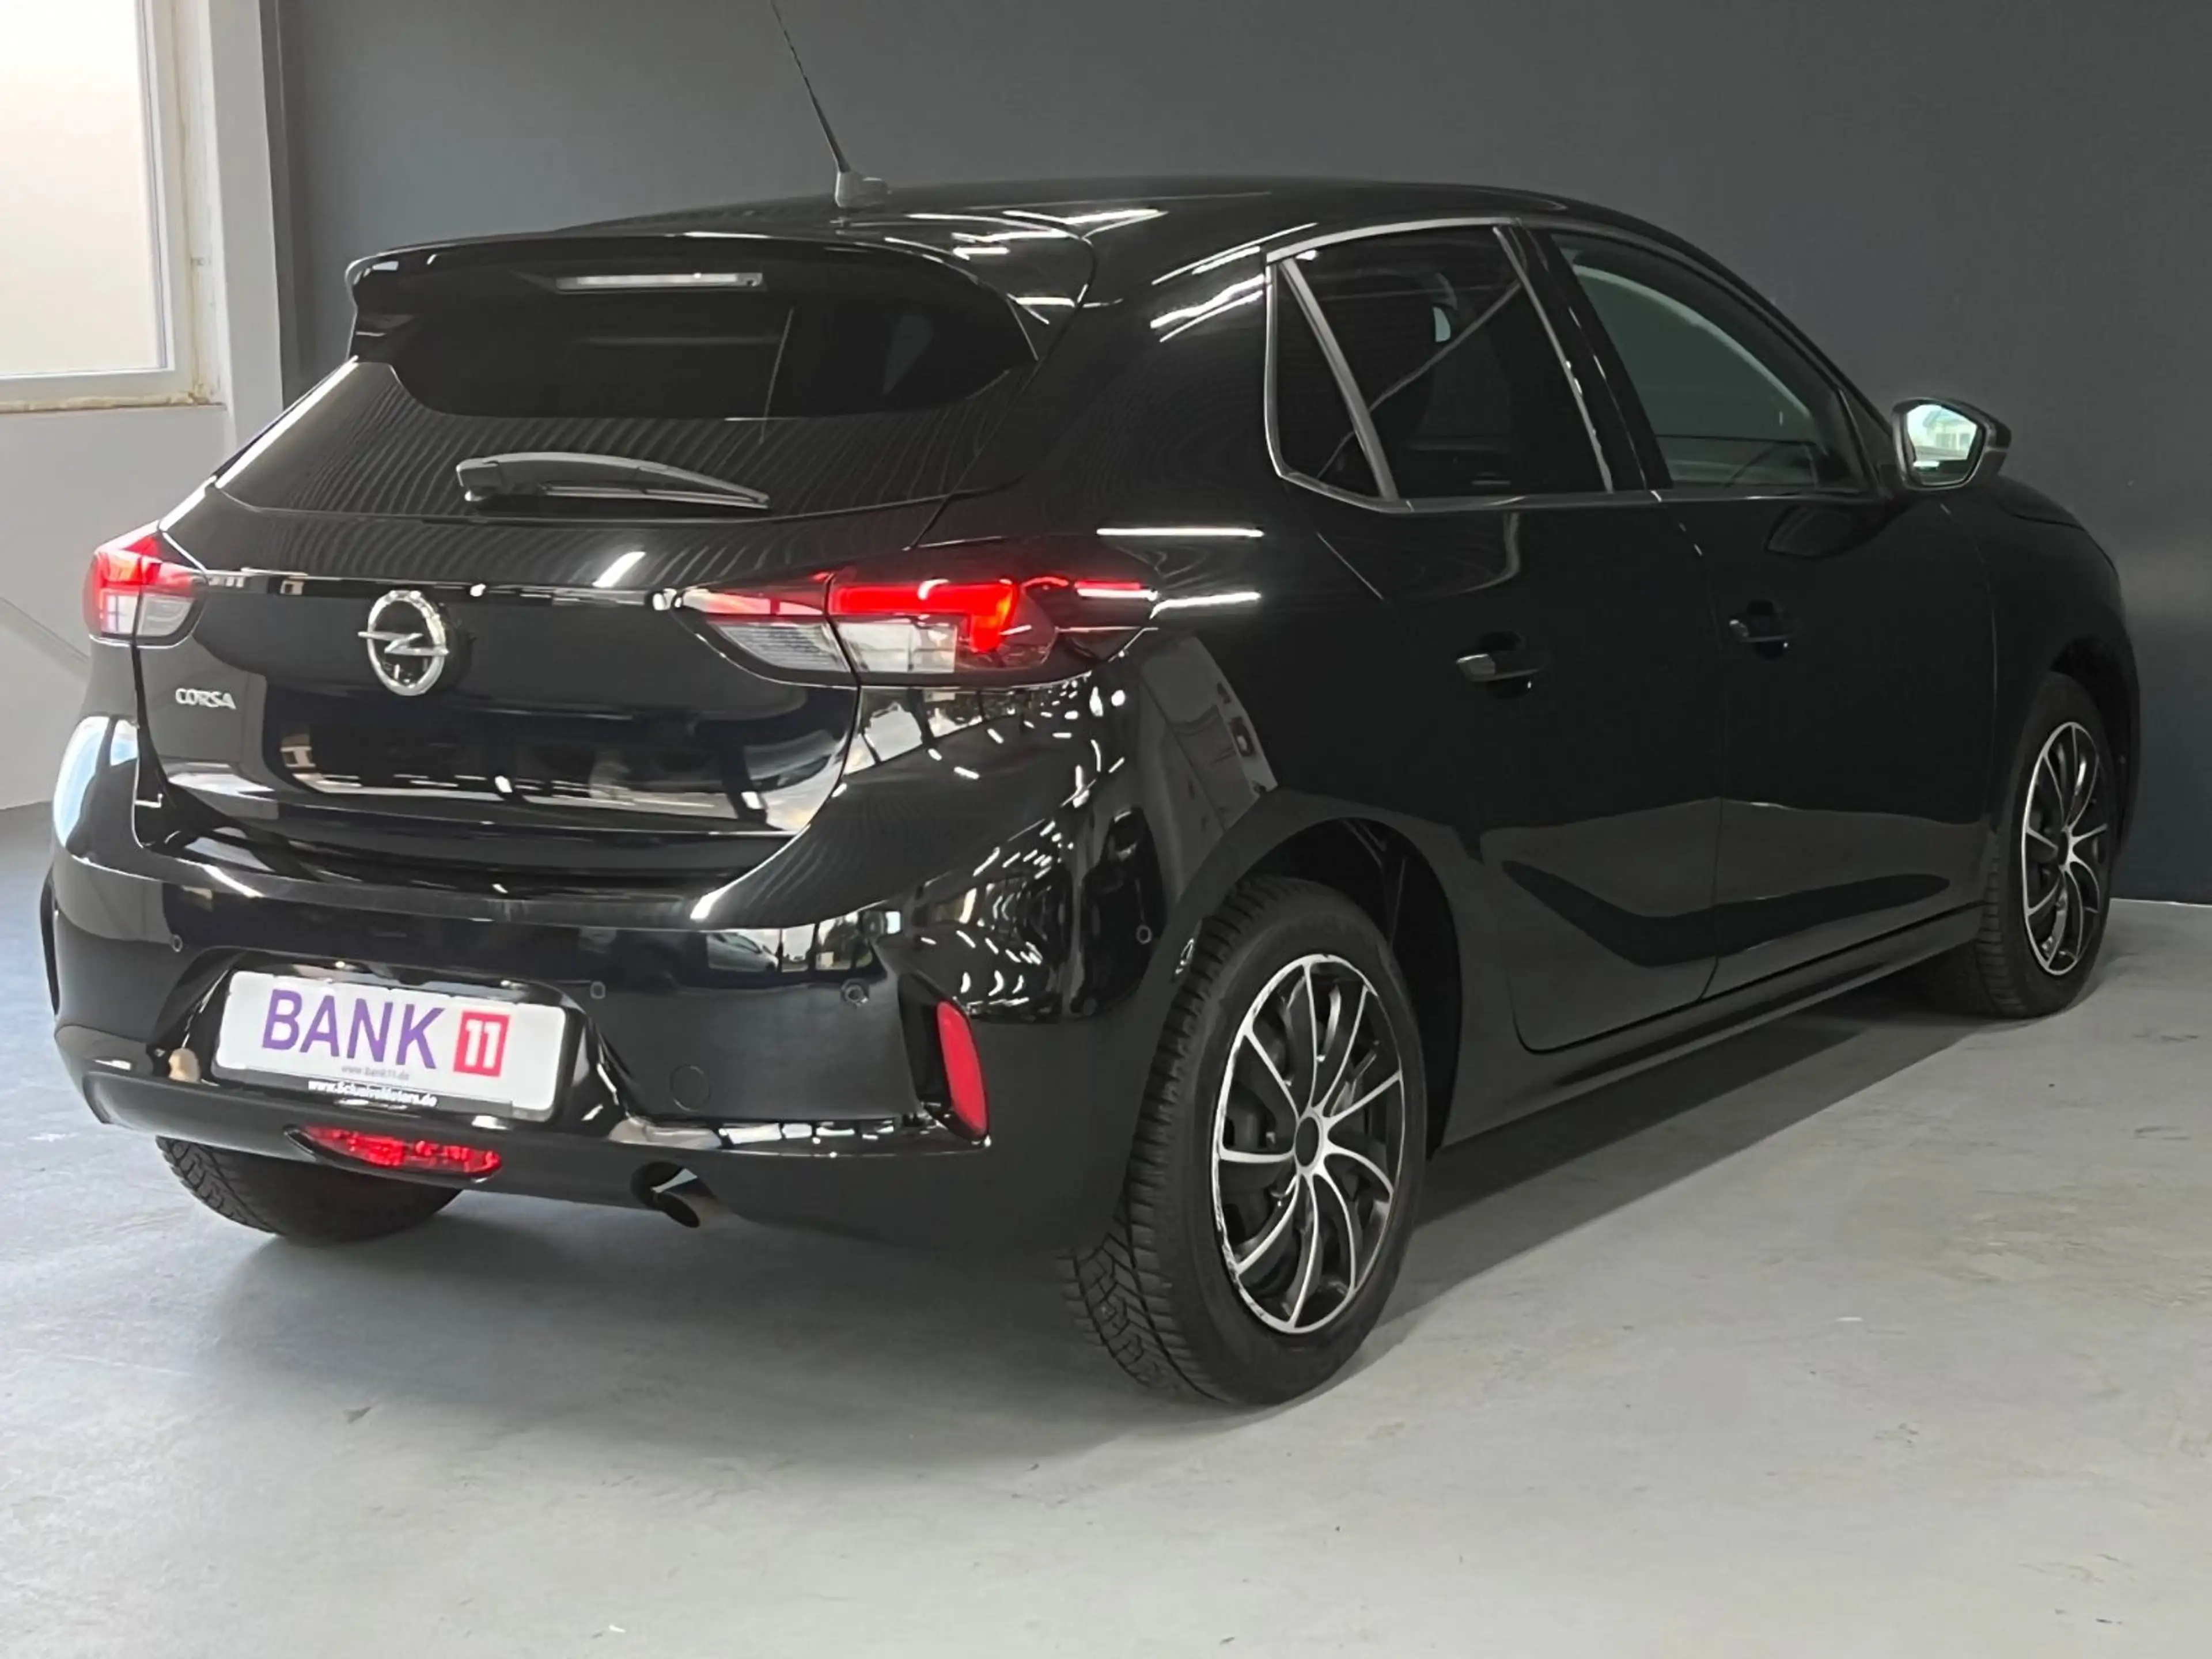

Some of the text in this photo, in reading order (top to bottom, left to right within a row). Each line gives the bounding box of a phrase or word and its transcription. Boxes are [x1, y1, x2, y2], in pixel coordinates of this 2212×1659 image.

[175, 688, 237, 710] CORSA
[262, 988, 502, 1069] BANK 11
